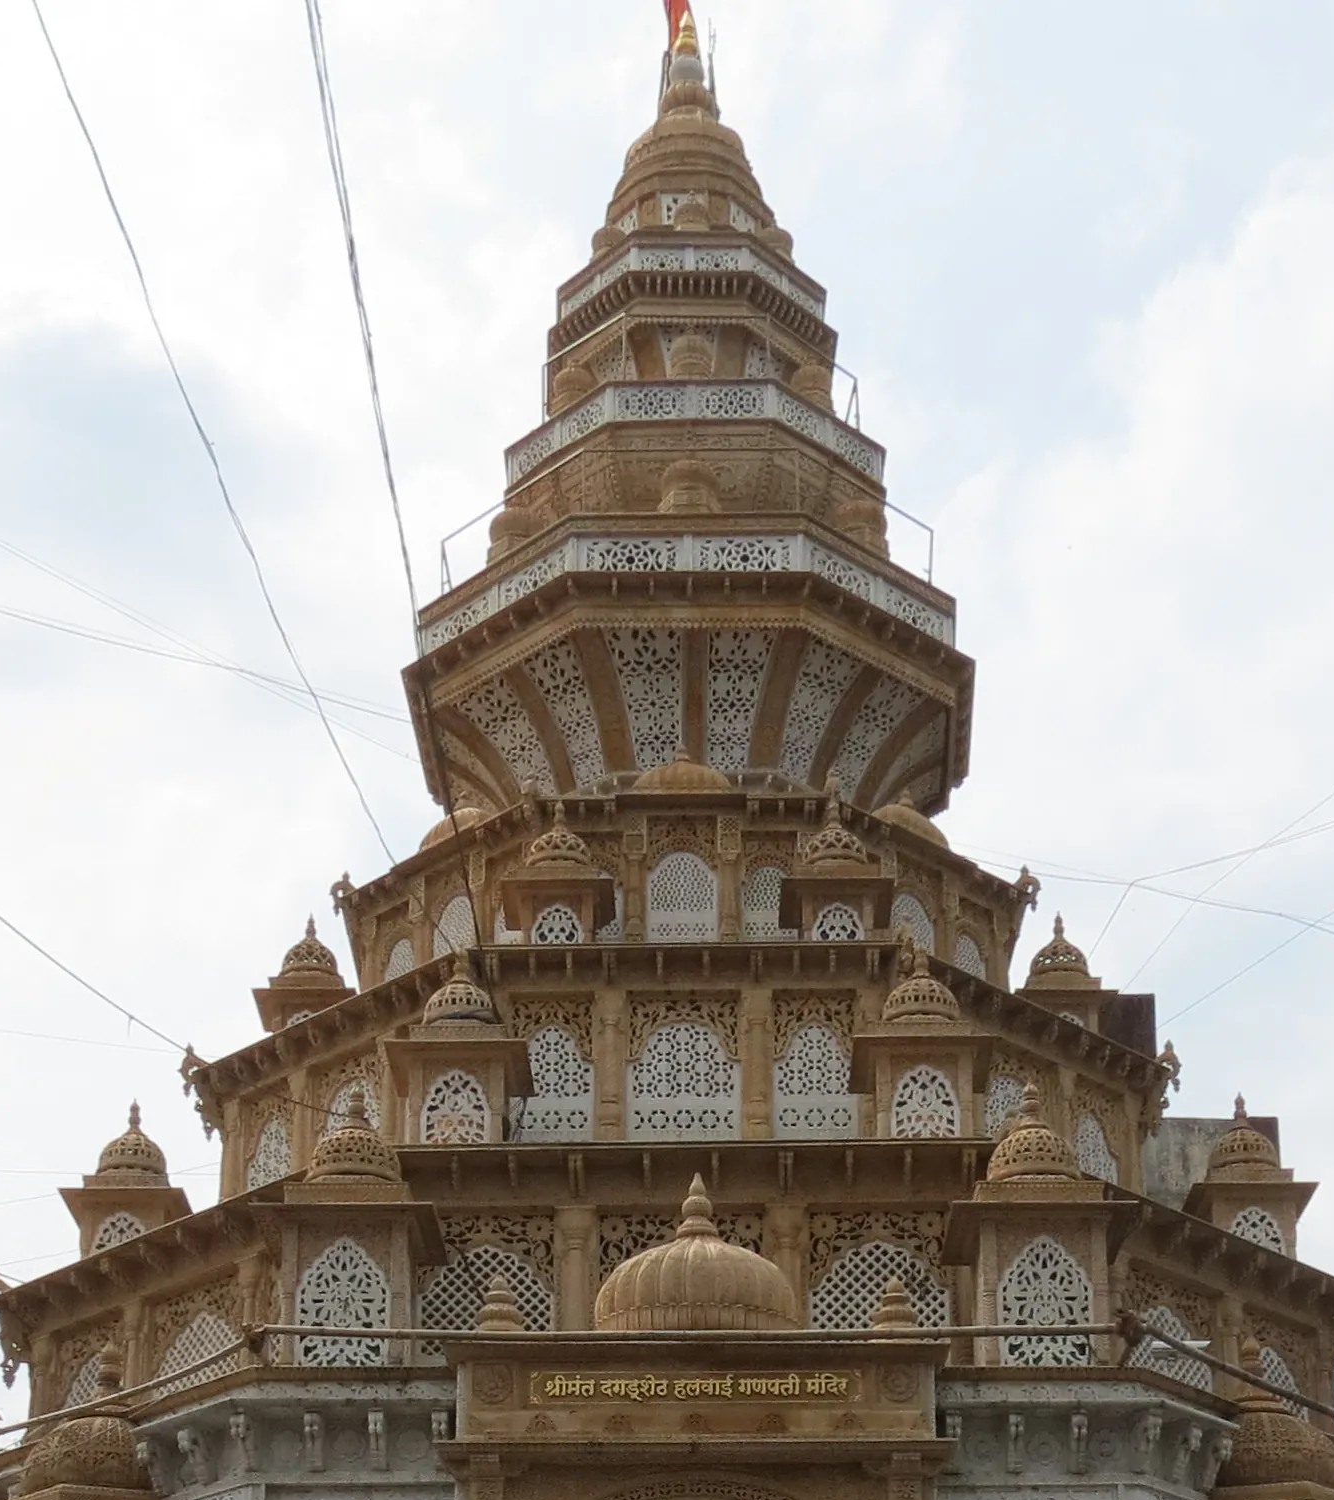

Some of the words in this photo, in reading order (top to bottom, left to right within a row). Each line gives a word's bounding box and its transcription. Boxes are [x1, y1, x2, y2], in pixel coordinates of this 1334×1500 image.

[544, 1374, 595, 1397] श्रीमंत
[599, 1374, 668, 1401] दगडूशेठ
[673, 1374, 734, 1399] हलवाई
[738, 1373, 800, 1396] गणपती
[805, 1373, 849, 1396] मंदिर
